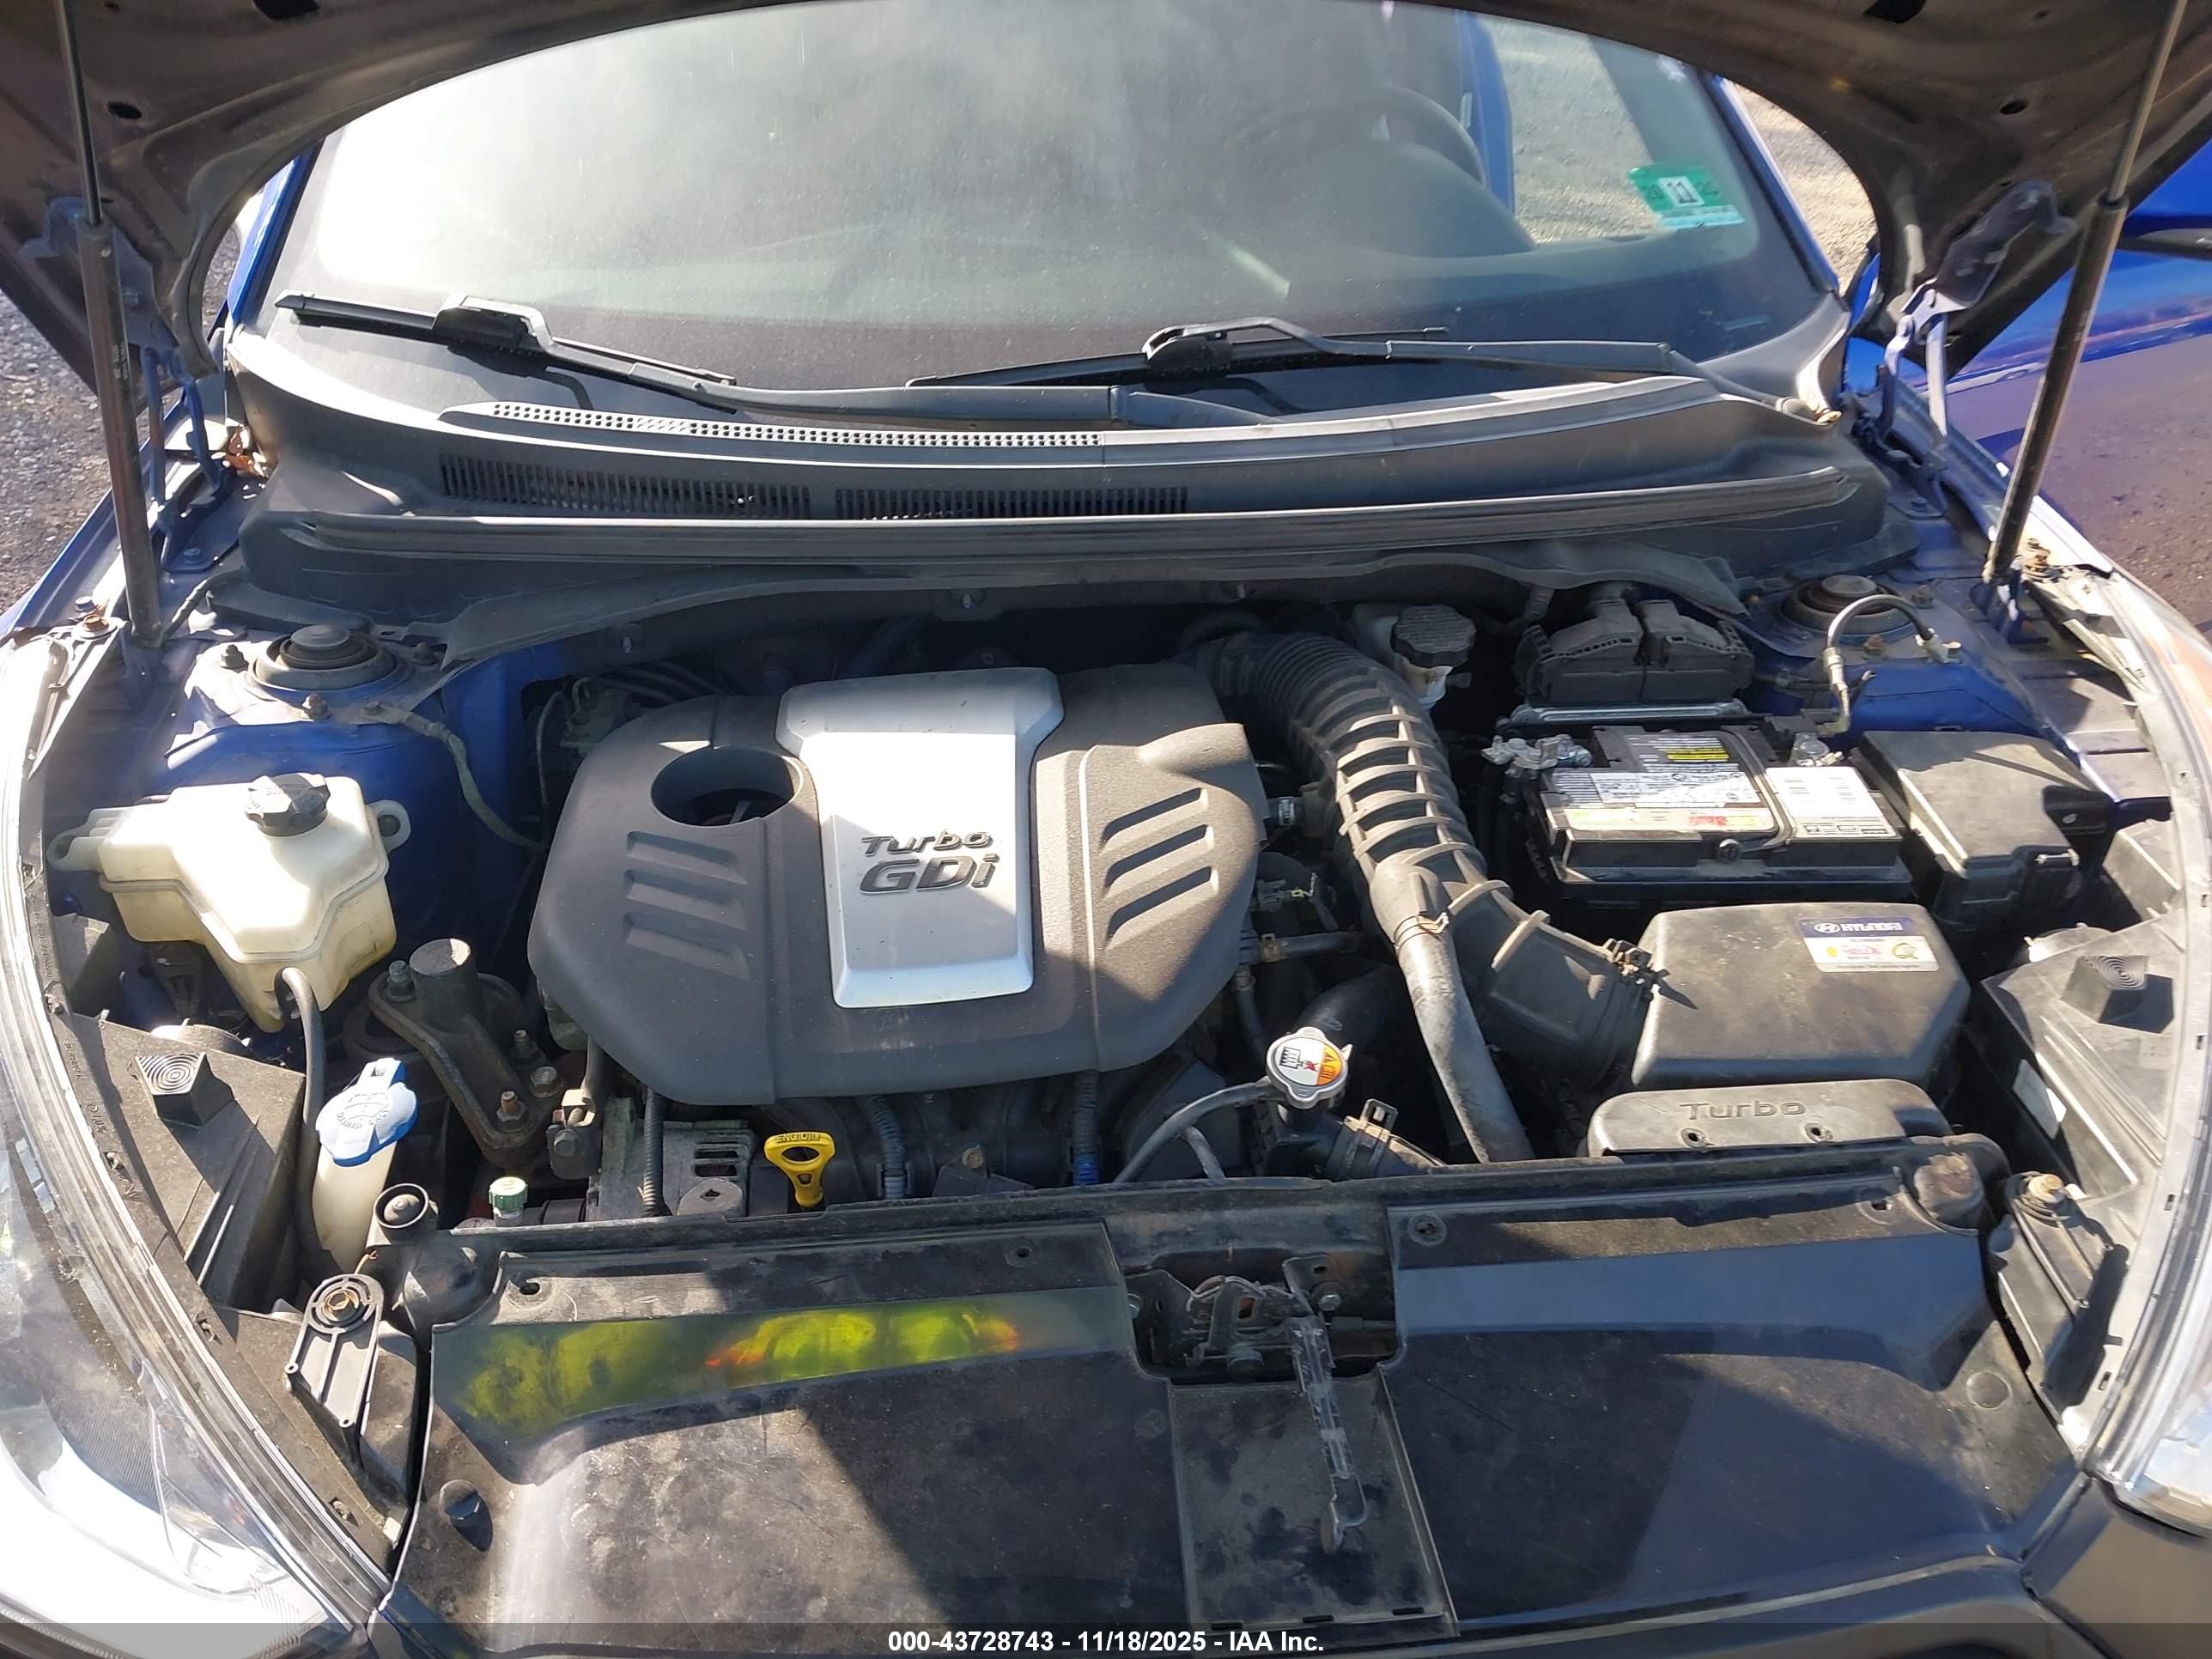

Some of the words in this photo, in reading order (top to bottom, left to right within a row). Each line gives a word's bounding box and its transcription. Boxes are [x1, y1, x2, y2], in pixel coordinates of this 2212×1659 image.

[1666, 181, 1698, 204] 11
[860, 831, 994, 857] Turbo
[859, 854, 1000, 895] GDi
[1678, 1100, 1807, 1121] Turbo
[775, 1133, 798, 1143] ENG
